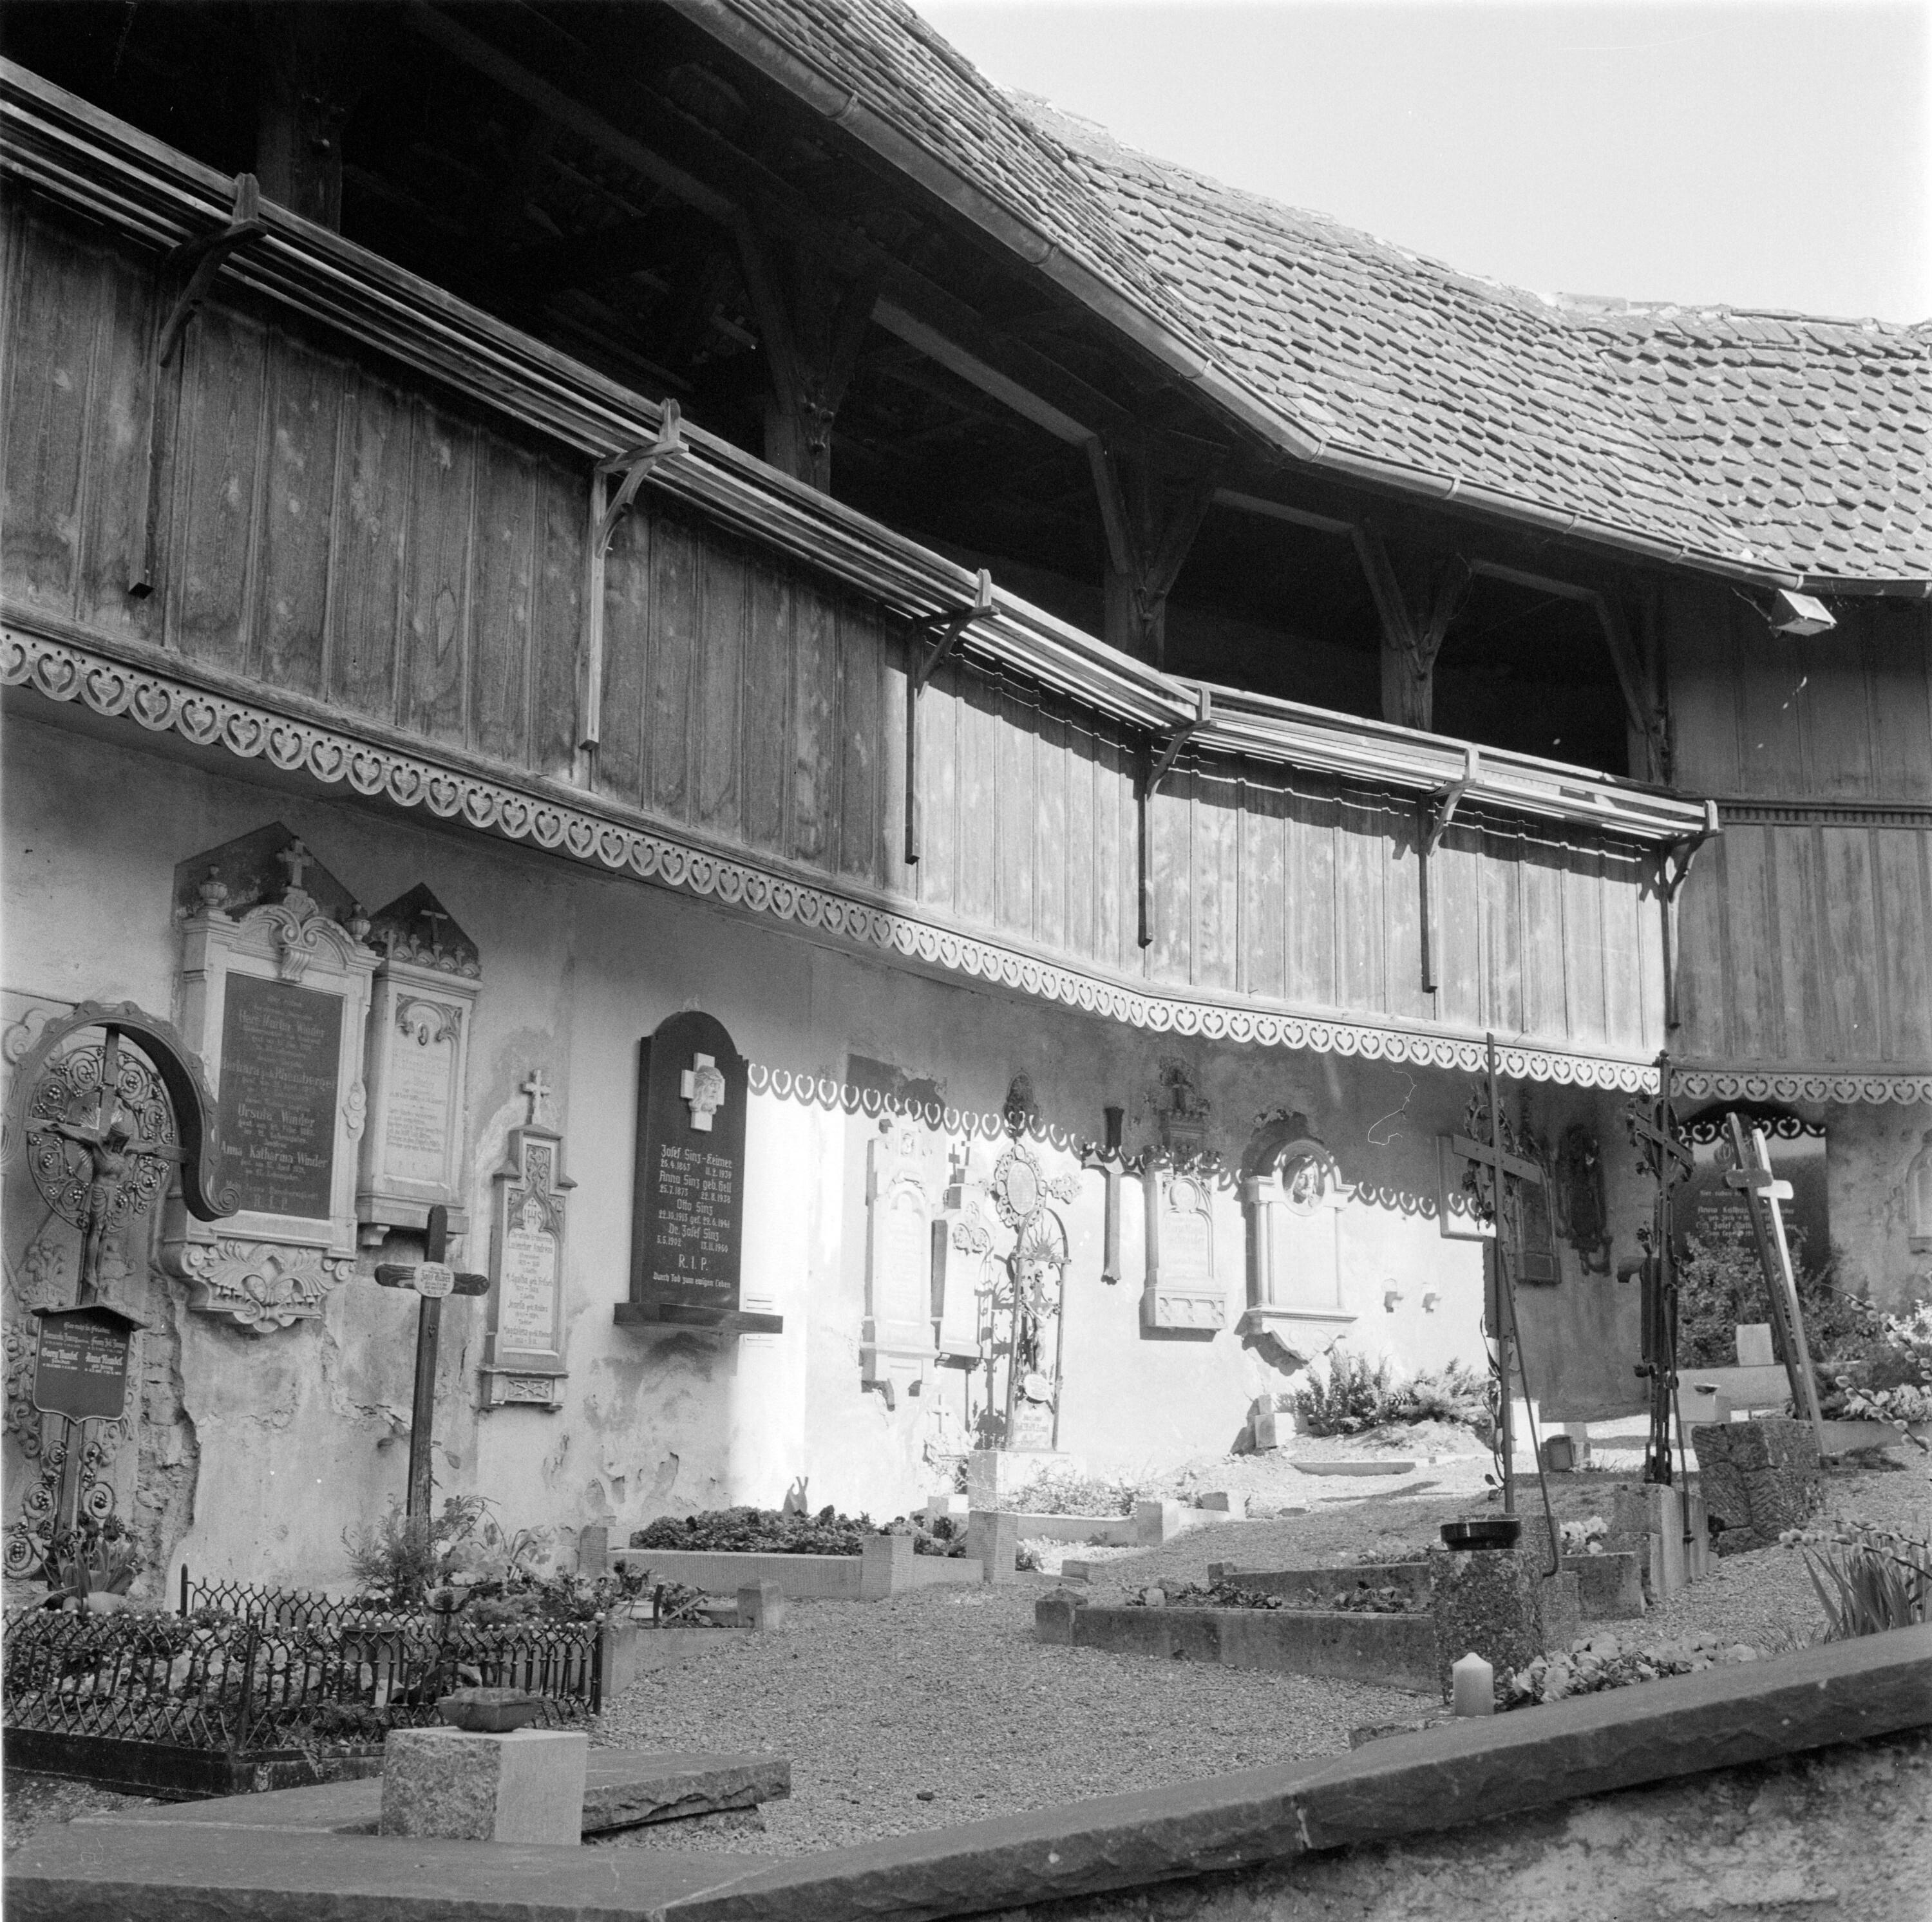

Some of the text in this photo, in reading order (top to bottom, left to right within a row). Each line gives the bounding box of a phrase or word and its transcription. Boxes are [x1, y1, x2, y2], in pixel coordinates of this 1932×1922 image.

[238, 1103, 272, 1121] Ursula
[281, 1109, 315, 1127] Winder
[221, 1141, 328, 1167] Anna Katharina Winder
[661, 1144, 681, 1159] Josef
[659, 1170, 681, 1184] Anna
[683, 1174, 700, 1189] Sinz
[677, 1199, 714, 1216] Otto Sinz
[668, 1223, 719, 1241] Dr. Josef Sinz
[678, 1254, 708, 1271] R. I. P.
